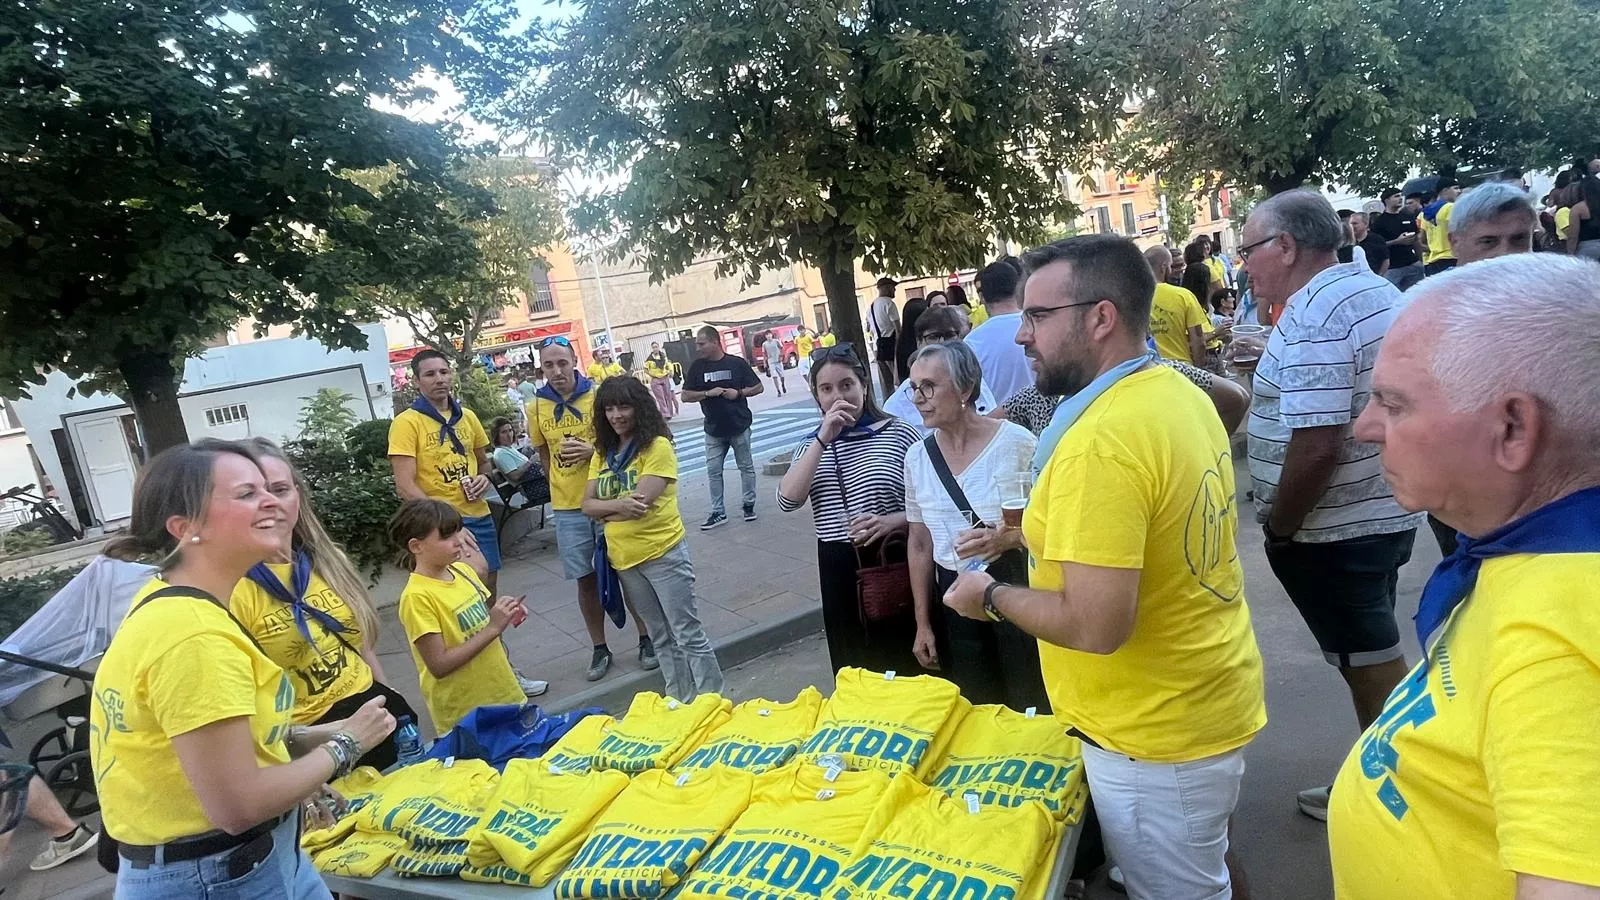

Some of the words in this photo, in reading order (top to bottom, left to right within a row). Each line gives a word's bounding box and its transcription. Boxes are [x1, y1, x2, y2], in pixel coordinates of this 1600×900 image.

[851, 757, 902, 771] LETICIA
[627, 823, 679, 834] FIESTAS
[772, 828, 826, 847] FIESTAS
[913, 848, 973, 869] FIESTAS
[569, 868, 608, 877] SANTA
[613, 868, 663, 878] LETICIA
[710, 875, 753, 889] SANTA
